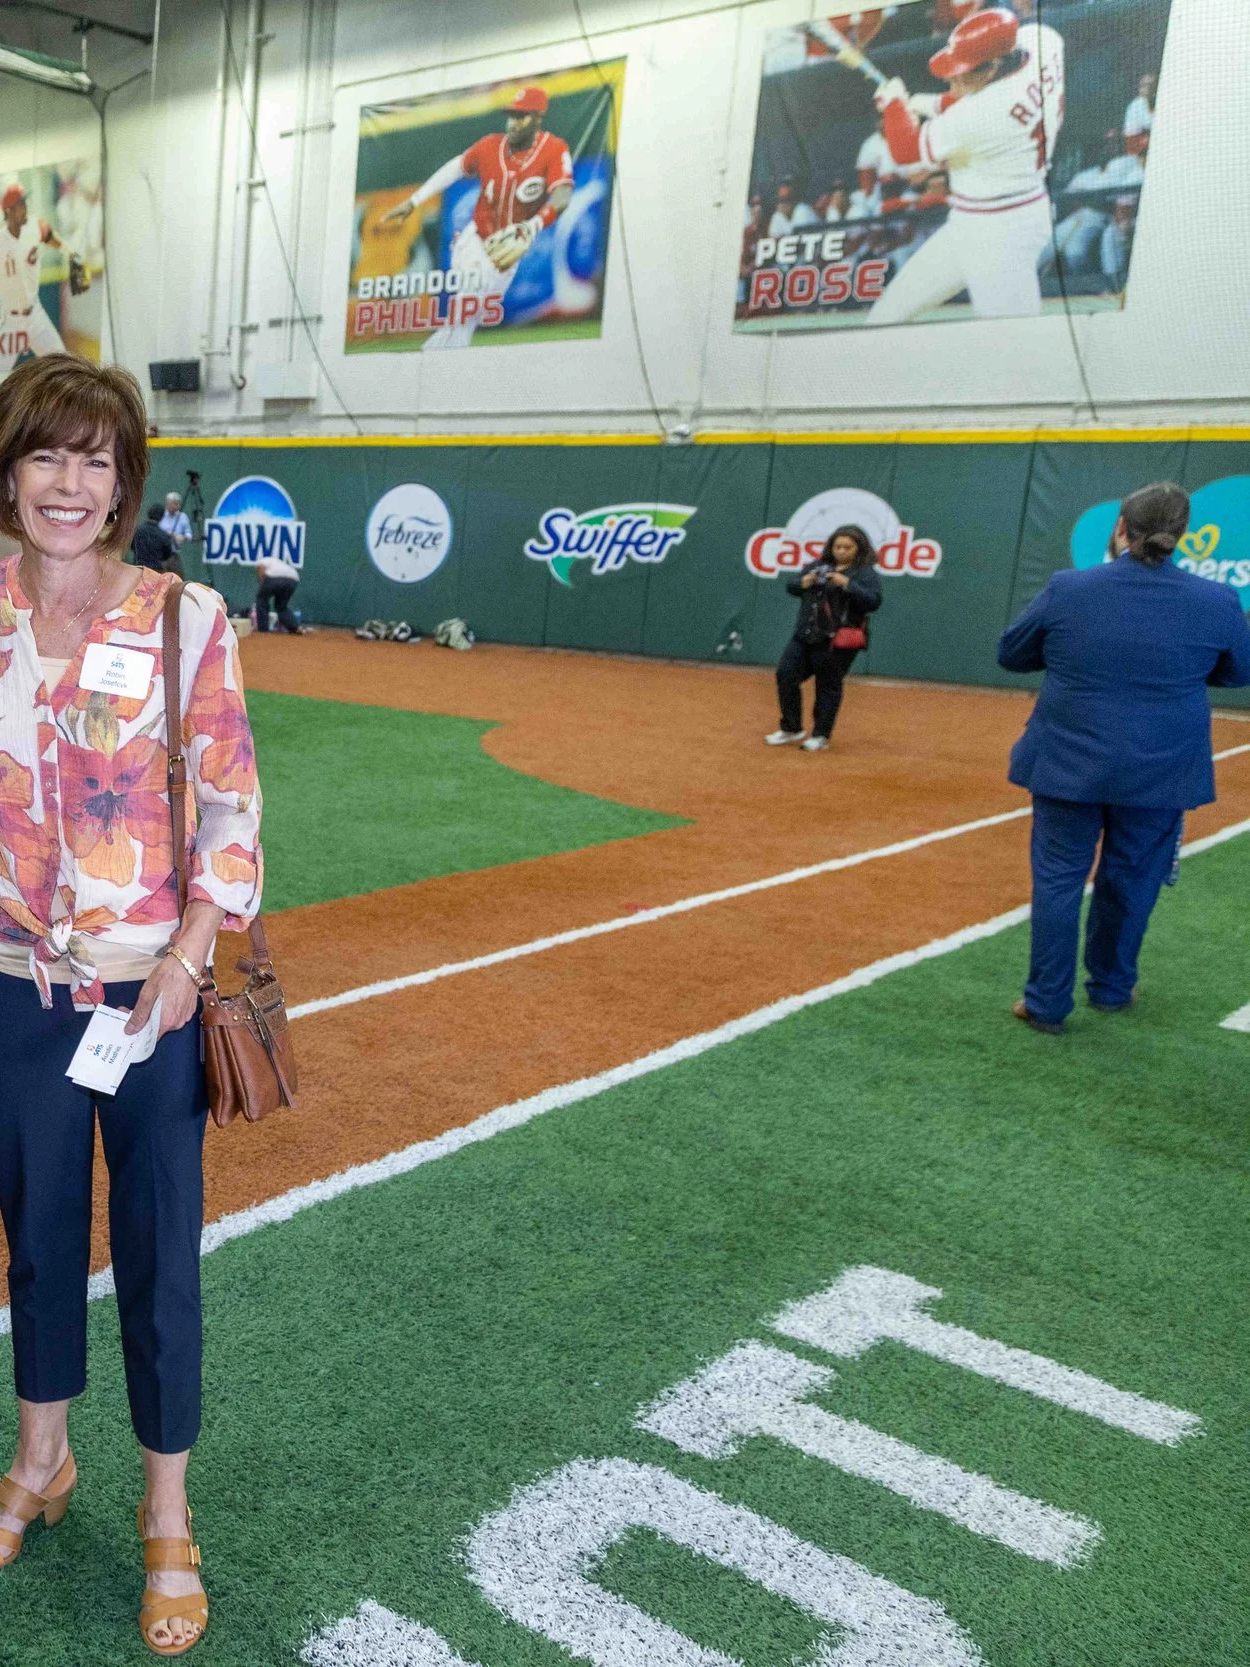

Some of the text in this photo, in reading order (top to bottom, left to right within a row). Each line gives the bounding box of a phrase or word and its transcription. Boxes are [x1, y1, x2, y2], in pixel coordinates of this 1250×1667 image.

[754, 231, 847, 268] PETE
[357, 266, 482, 300] BRANDON
[750, 260, 890, 311] ROSE
[355, 294, 504, 335] PHILLIPS
[205, 523, 302, 565] DAWN
[374, 513, 444, 550] febreze
[529, 513, 680, 570] Swiffer
[750, 531, 937, 574] Casde
